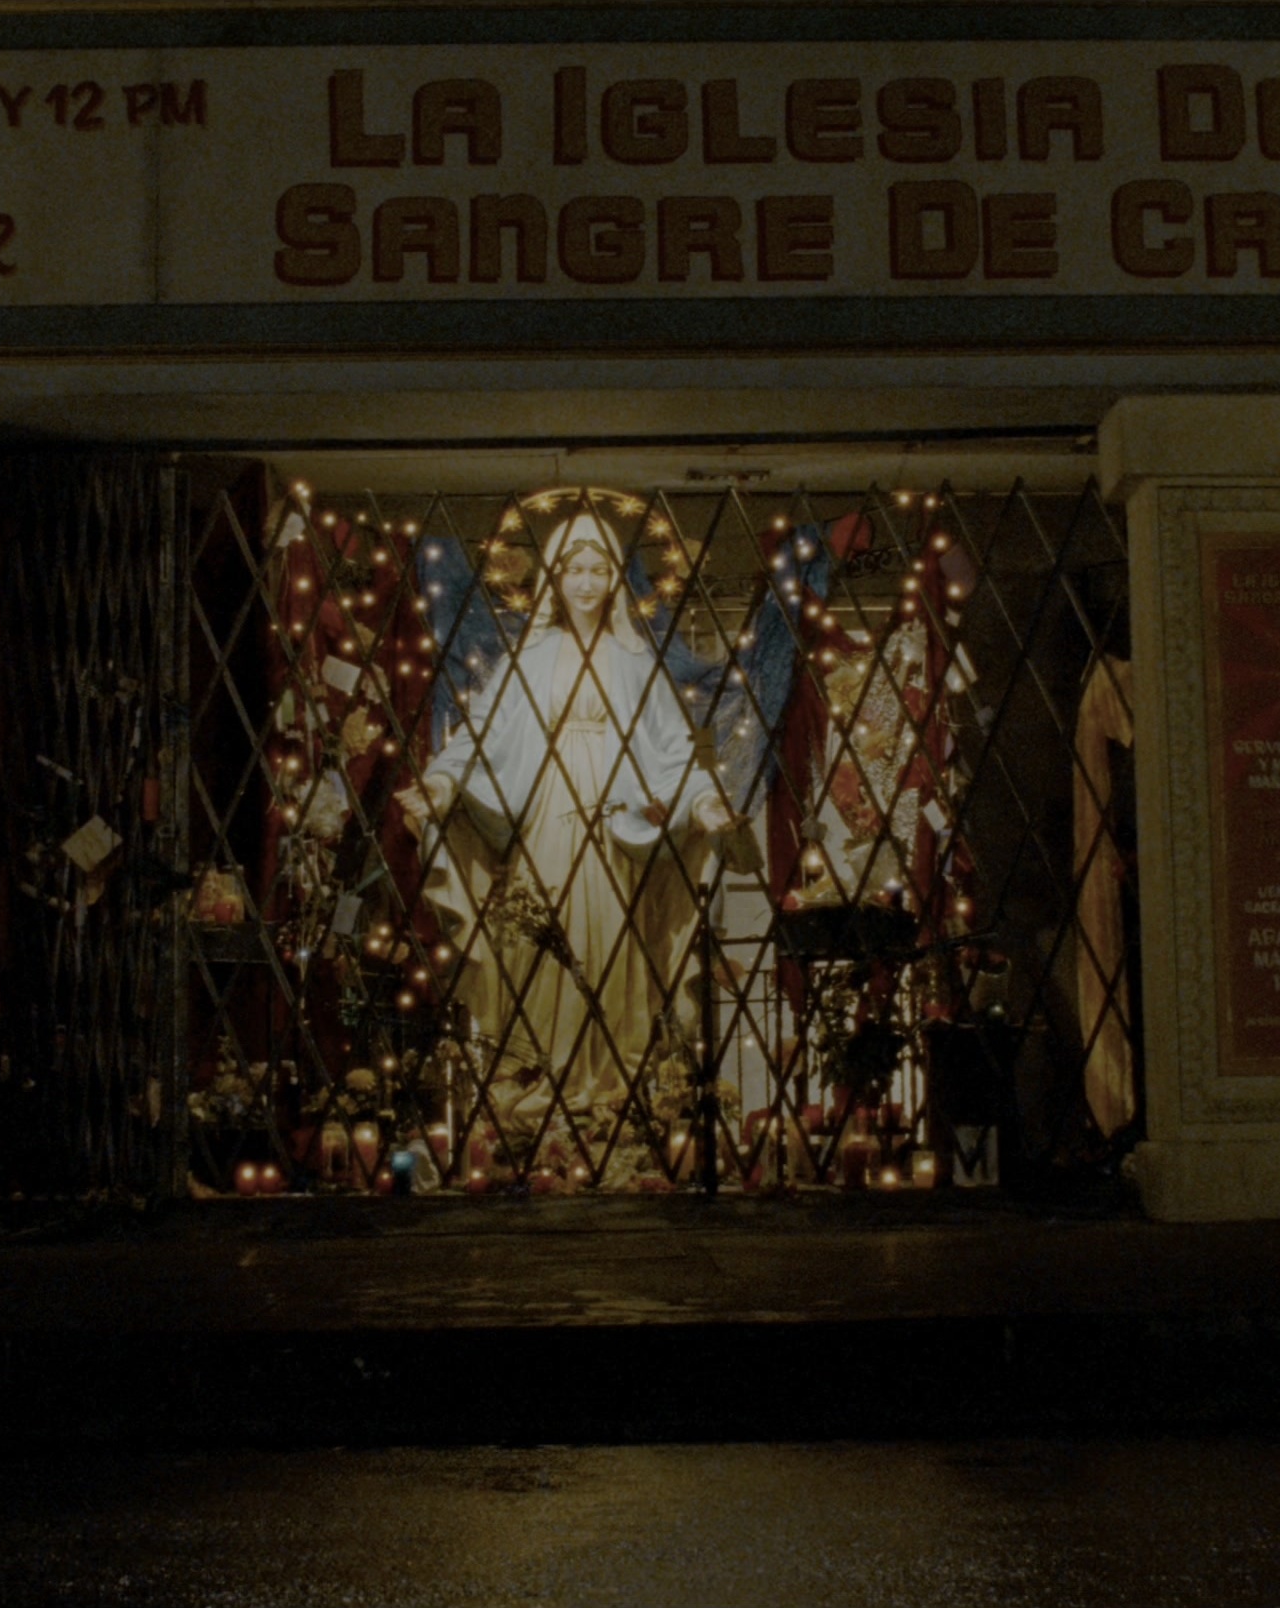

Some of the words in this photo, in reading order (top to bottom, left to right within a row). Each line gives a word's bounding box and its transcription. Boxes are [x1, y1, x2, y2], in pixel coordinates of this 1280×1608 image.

[46, 82, 103, 130] 12
[126, 81, 205, 125] PM
[328, 69, 504, 167] LA
[553, 66, 1104, 166] IGLESIA
[888, 179, 1058, 280] DE
